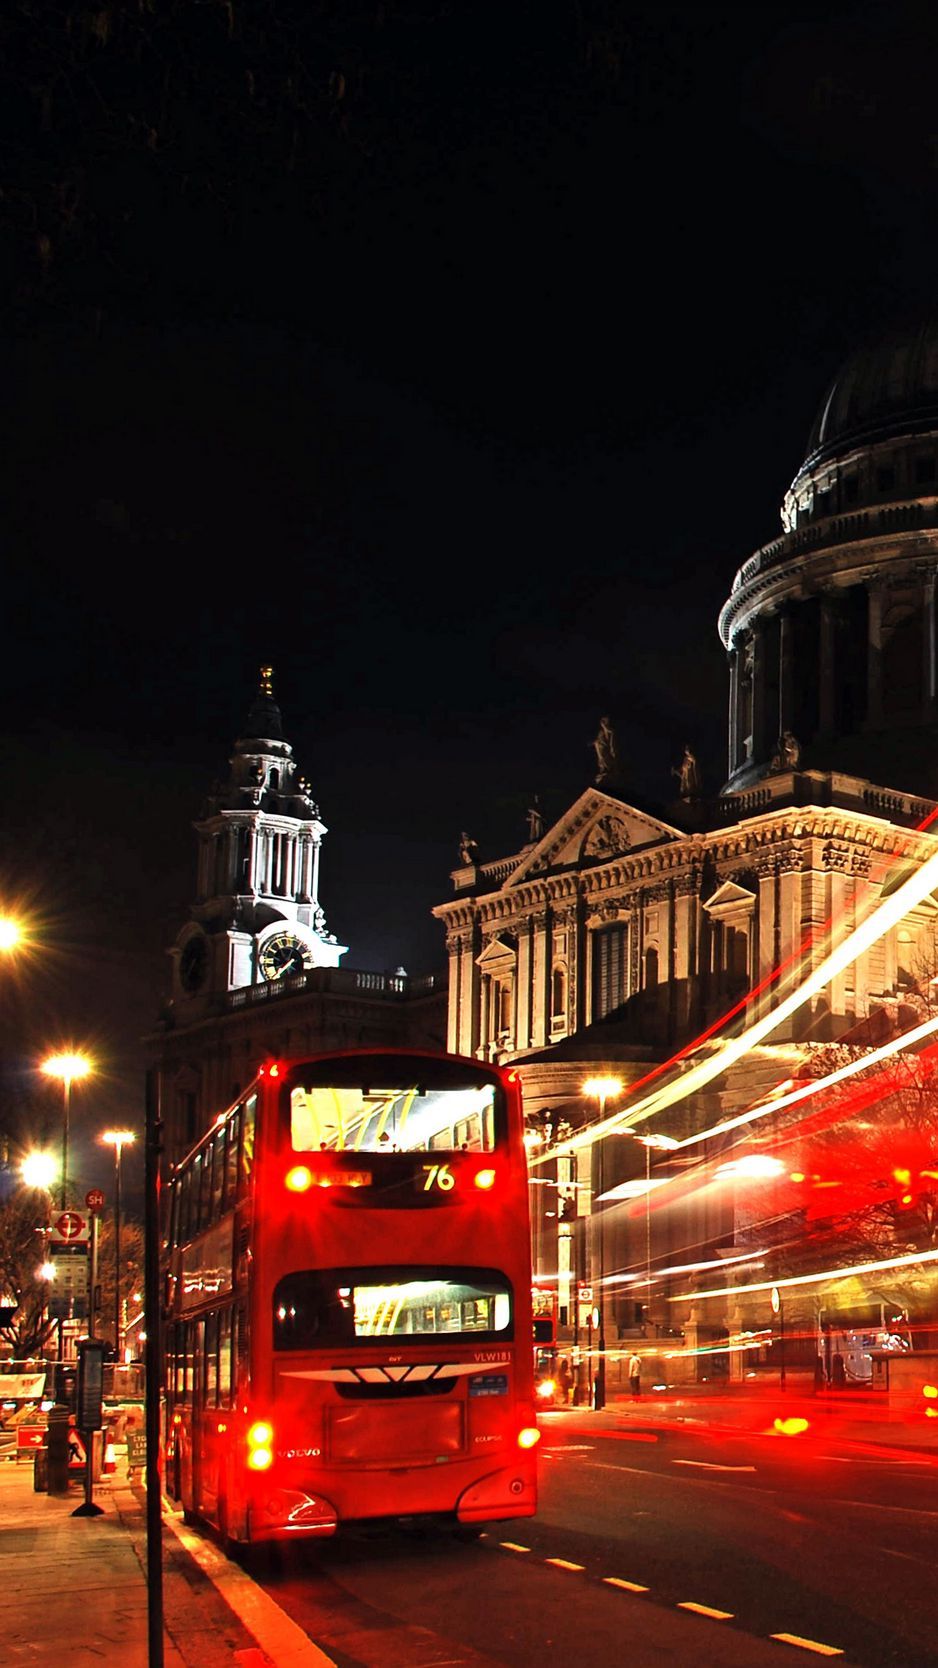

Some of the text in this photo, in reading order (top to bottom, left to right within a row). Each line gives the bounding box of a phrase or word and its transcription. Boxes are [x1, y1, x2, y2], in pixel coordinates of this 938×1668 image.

[423, 1164, 455, 1191] 76
[88, 1195, 103, 1205] SH
[474, 1352, 511, 1362] VLW181
[277, 1448, 321, 1458] VOLVO
